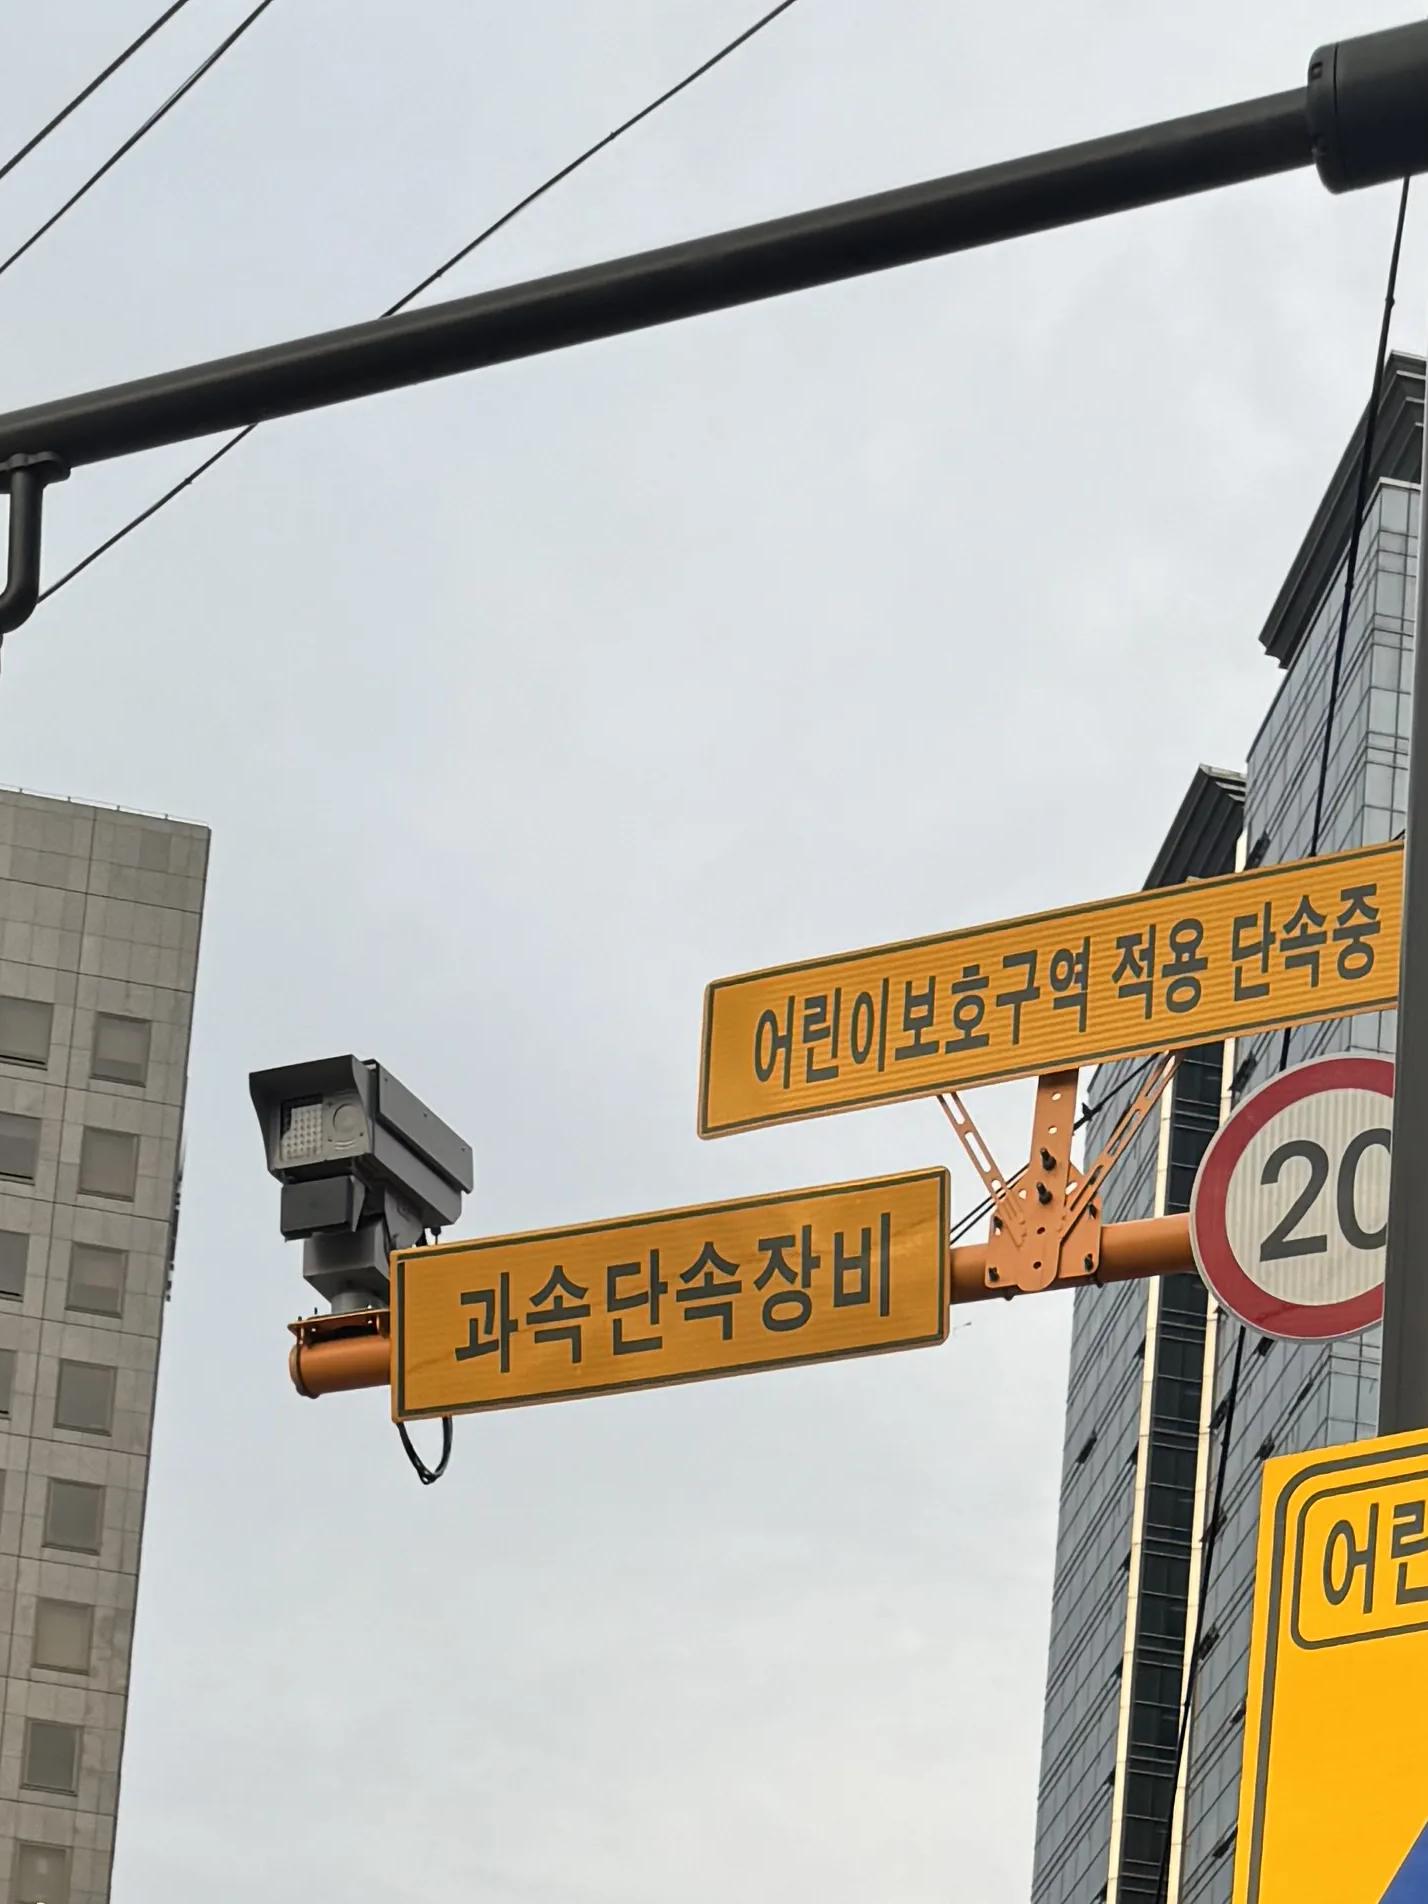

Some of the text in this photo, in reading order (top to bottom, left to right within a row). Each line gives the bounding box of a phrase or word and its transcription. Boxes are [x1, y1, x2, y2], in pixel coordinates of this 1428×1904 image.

[752, 881, 1383, 1087] 어린이보호구역 적용 단속중
[1258, 1124, 1391, 1262] 20
[453, 1211, 894, 1376] 과속단속장비
